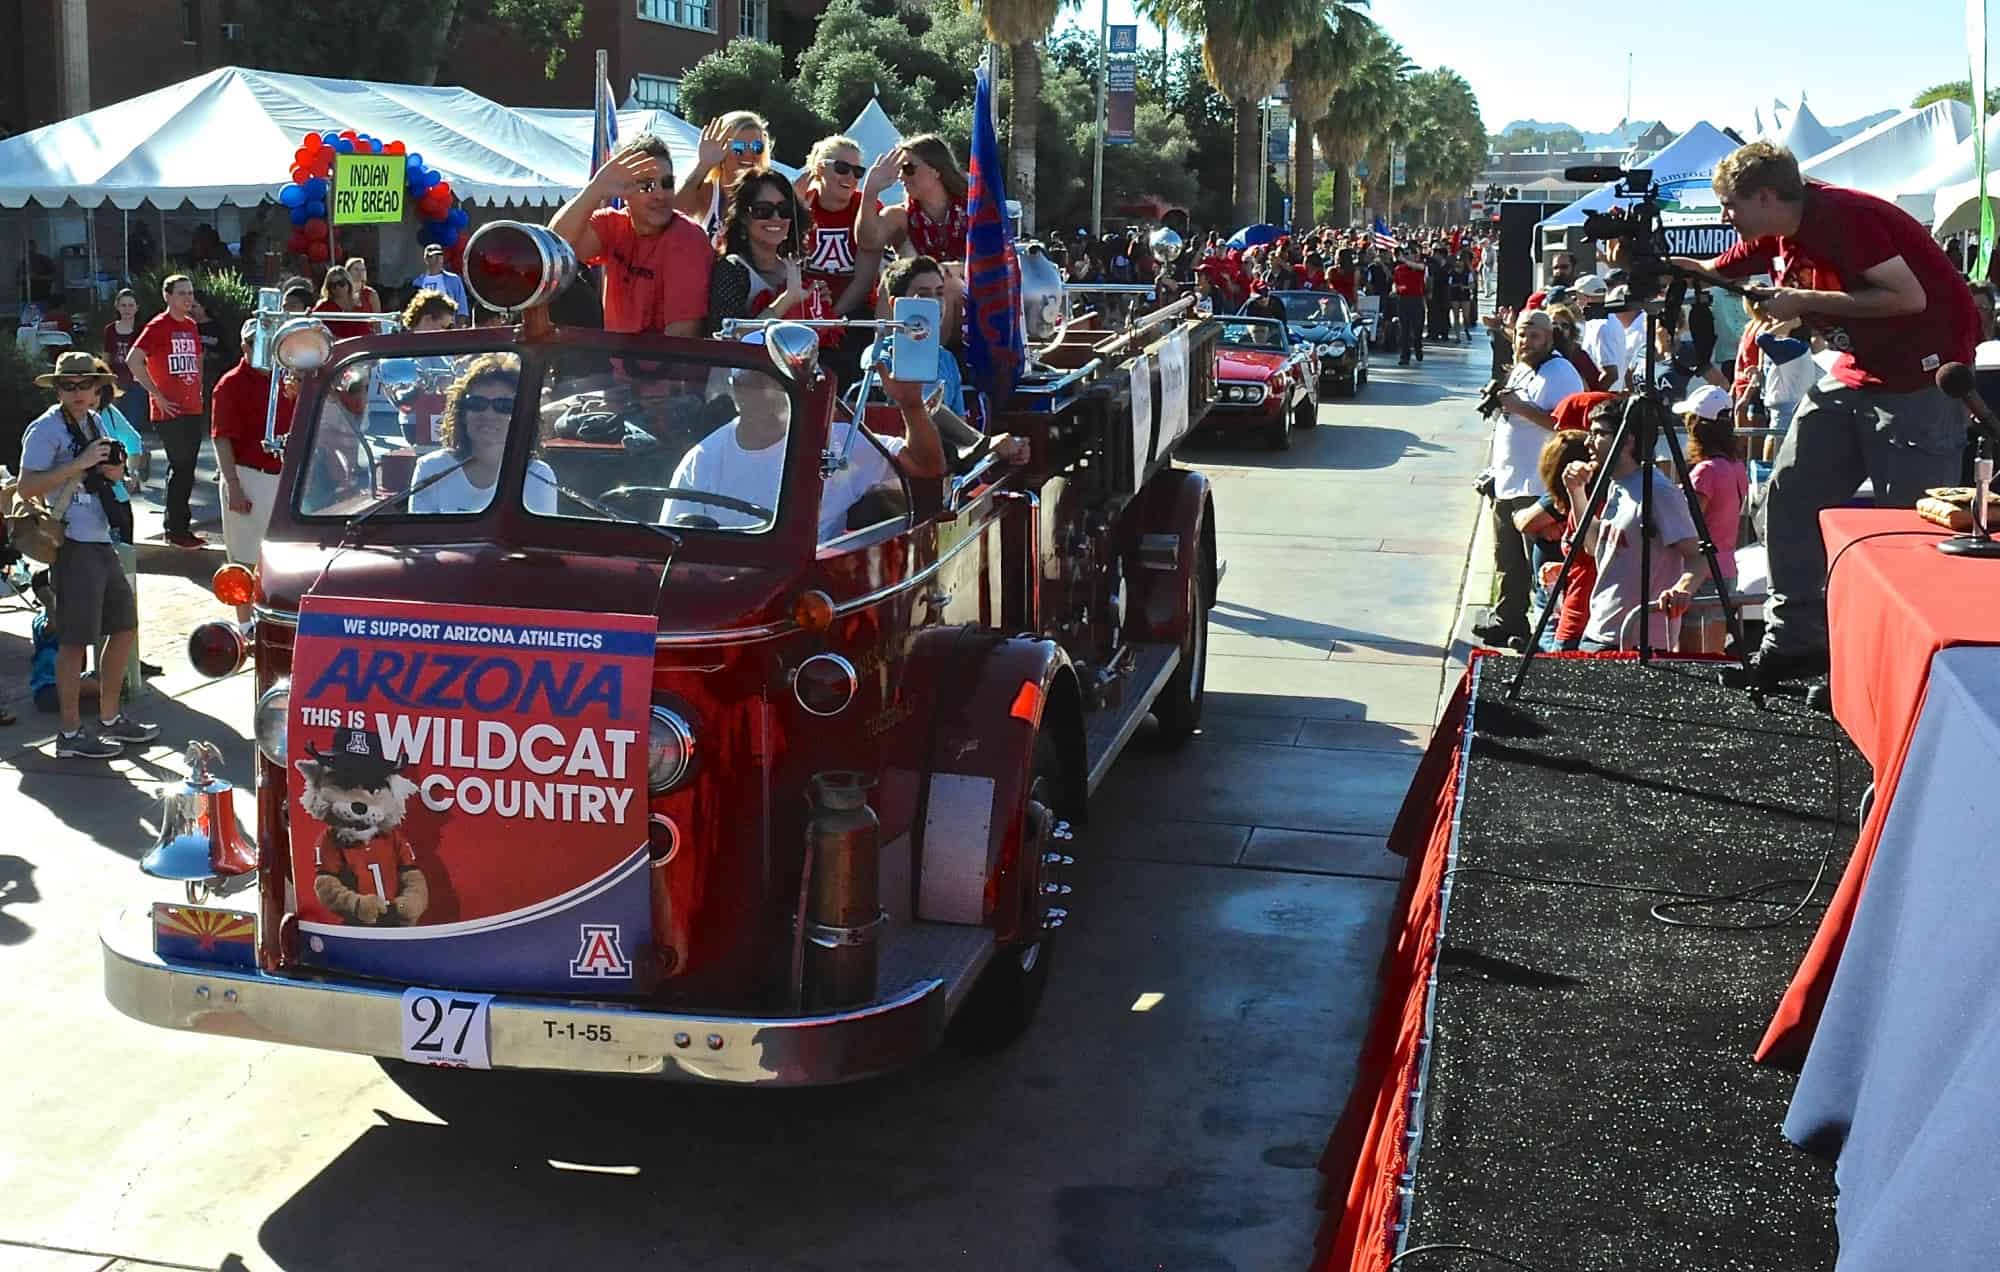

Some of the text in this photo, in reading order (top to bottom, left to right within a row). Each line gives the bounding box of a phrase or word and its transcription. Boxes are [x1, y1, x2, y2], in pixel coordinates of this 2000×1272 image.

[350, 164, 389, 188] INDIAN
[336, 190, 400, 214] FRY BREAD
[804, 227, 857, 273] A
[1664, 228, 1737, 255] SHAMRO
[344, 618, 603, 649] WE SUPPORT ARIZONA ATHLETICS
[303, 647, 624, 721] ARIZONA
[301, 707, 636, 779] THIS IS WILDCAT
[420, 773, 634, 824] COUNTRY
[569, 923, 633, 979] A
[410, 995, 481, 1055] 27
[543, 1020, 612, 1043] T-1-55
